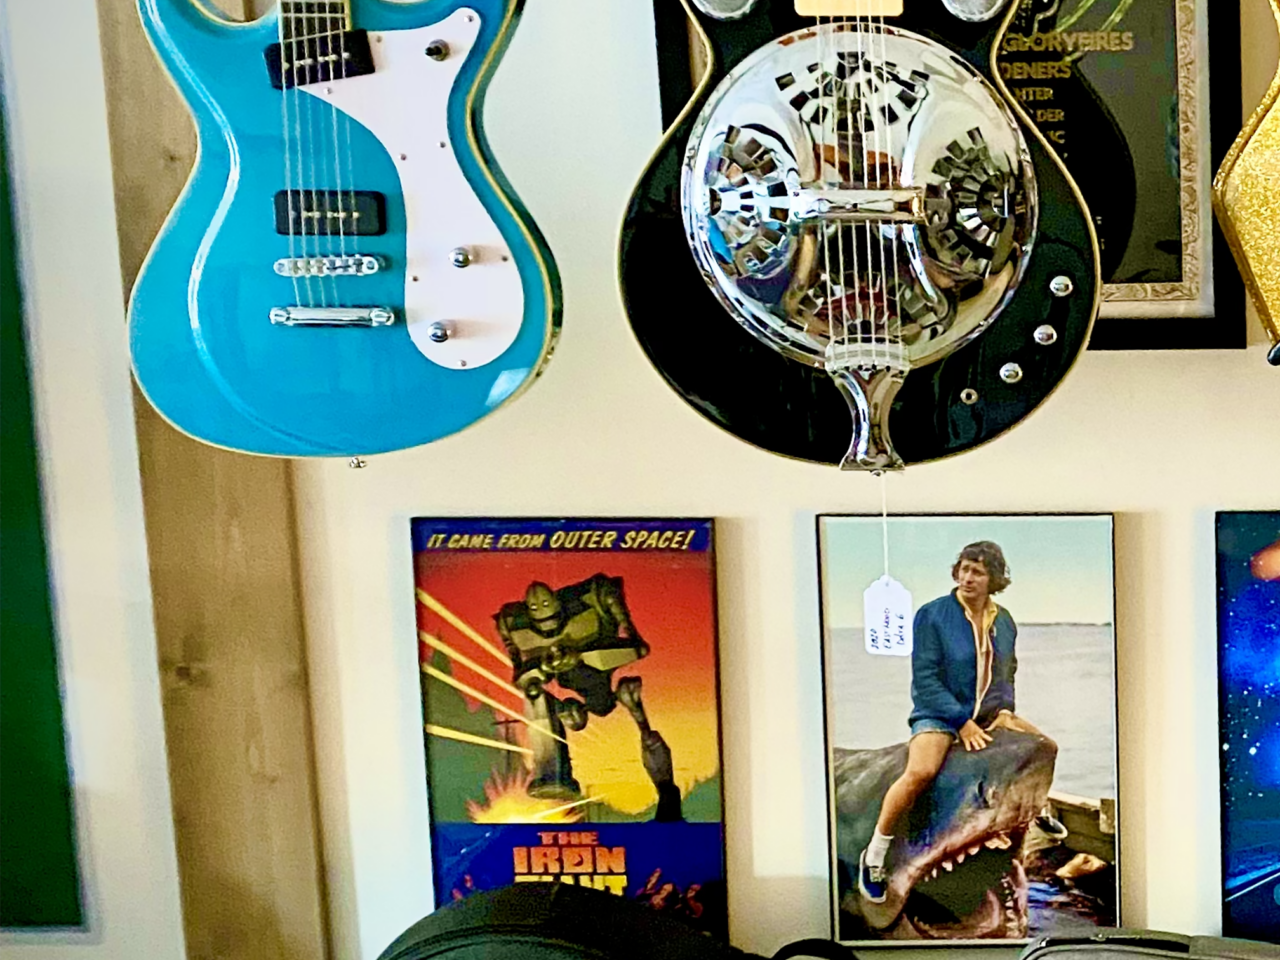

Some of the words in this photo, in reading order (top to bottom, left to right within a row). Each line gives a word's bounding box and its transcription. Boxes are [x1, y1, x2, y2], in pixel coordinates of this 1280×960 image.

[427, 534, 447, 548] IT
[447, 534, 493, 549] CAME
[497, 533, 545, 549] FROM
[550, 530, 618, 549] OUTER
[620, 529, 696, 550] SPACE!
[537, 831, 600, 845] THE
[513, 846, 627, 874] IRON
